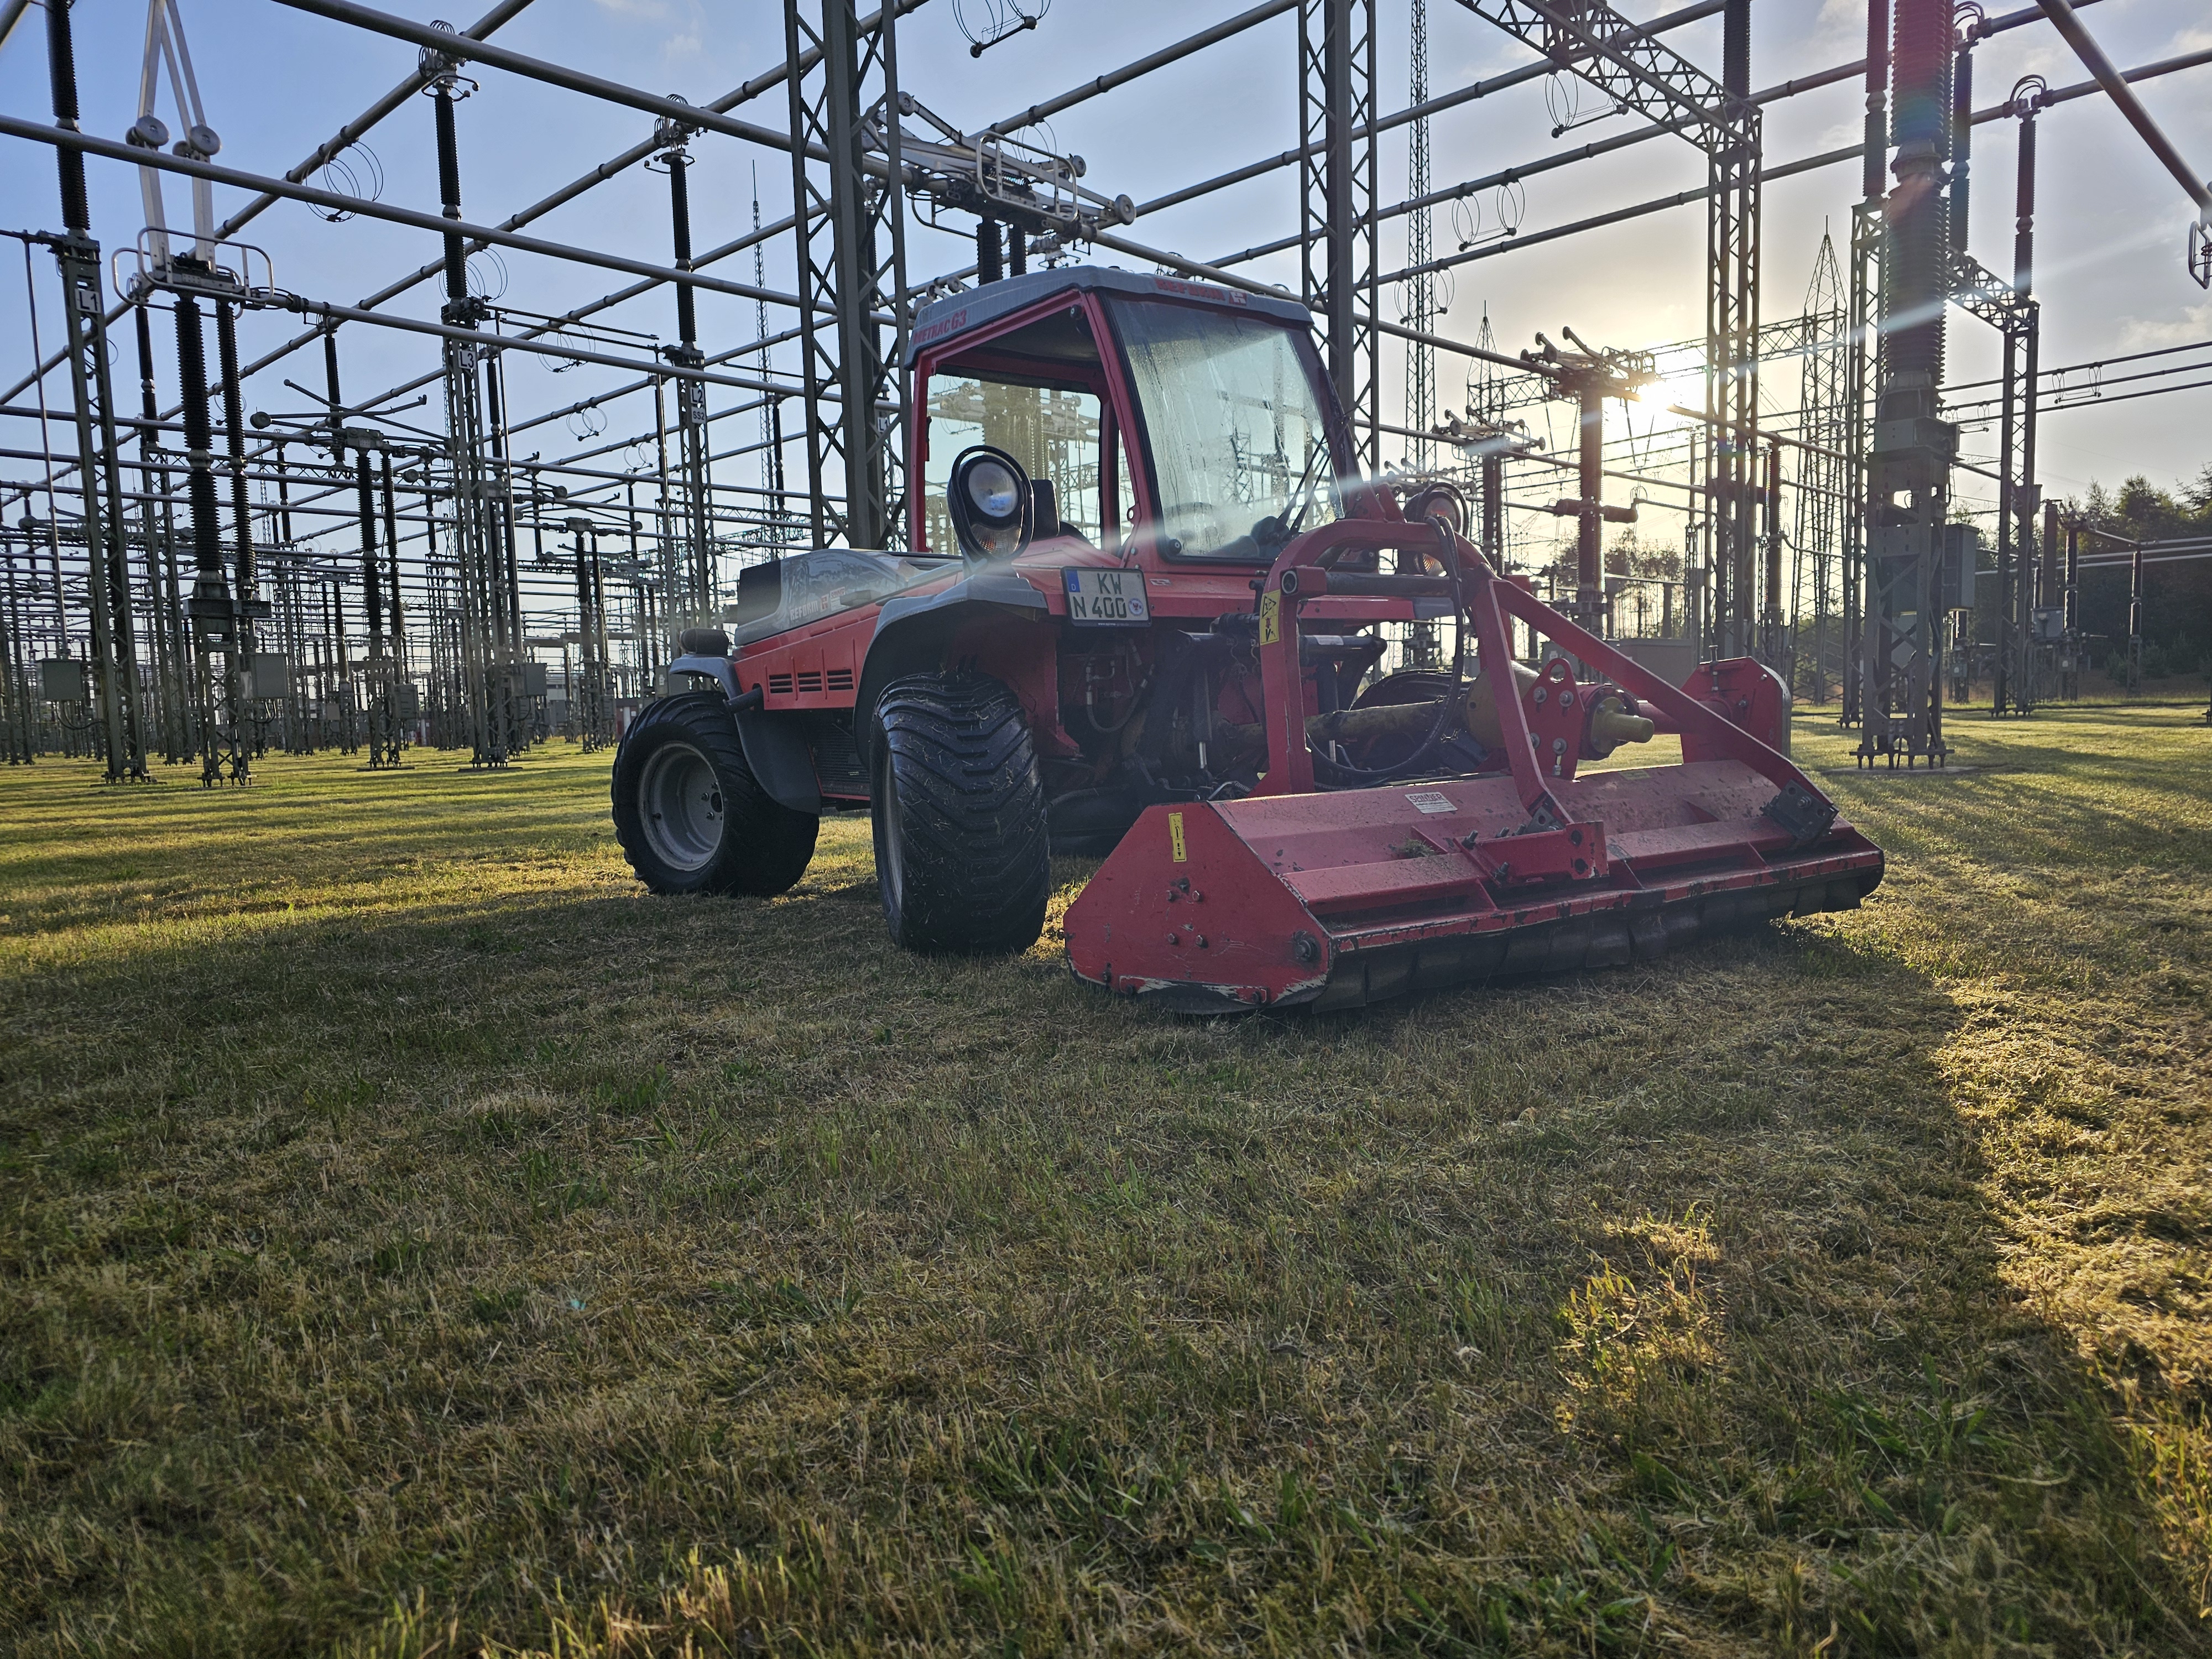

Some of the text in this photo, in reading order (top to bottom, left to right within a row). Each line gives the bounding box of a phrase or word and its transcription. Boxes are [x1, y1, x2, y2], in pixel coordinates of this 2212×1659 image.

[79, 291, 98, 311] L1
[951, 310, 967, 330] G3
[460, 351, 474, 368] L3
[692, 388, 703, 403] L2
[693, 411, 705, 420] SS2
[879, 419, 888, 431] L1
[1097, 573, 1122, 595] KW
[790, 601, 818, 621] REFORM
[1073, 596, 1127, 618] N 400
[1409, 794, 1445, 803] SPINNER
